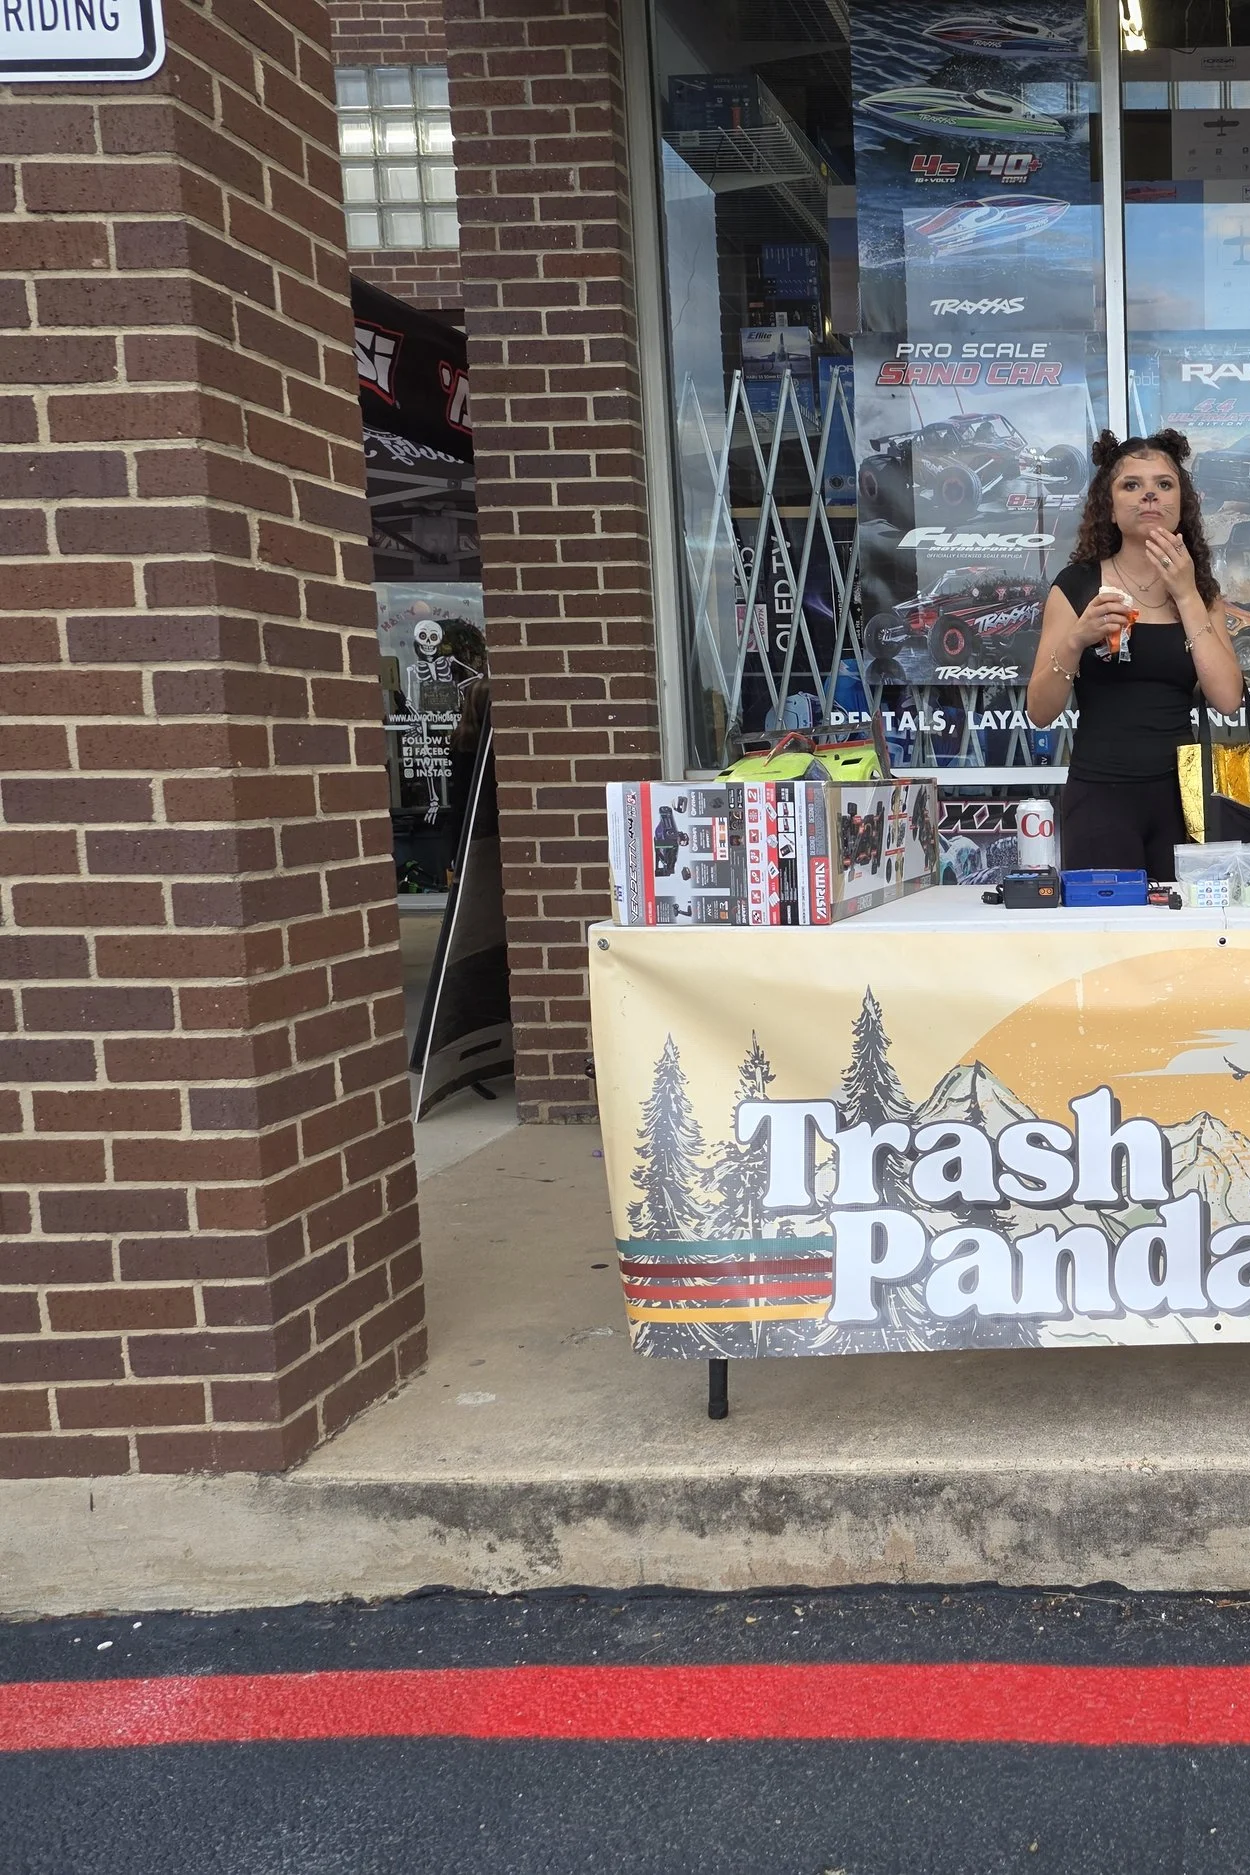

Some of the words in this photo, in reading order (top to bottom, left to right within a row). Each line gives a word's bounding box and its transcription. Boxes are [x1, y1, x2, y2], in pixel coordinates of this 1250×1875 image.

[918, 113, 957, 125] TRAXXAS
[930, 297, 1026, 316] TRAXXAS
[896, 343, 952, 358] PRO
[962, 343, 1048, 358] SCALE
[876, 361, 982, 386] SAND
[986, 361, 1063, 386] CAR
[898, 526, 1056, 548] FUNCO
[935, 665, 1019, 680] TRAXXAS
[967, 709, 1081, 731] LAYAAY
[402, 736, 443, 745] FOLLOW
[628, 838, 639, 924] VENDETTA
[734, 1085, 1172, 1210] Trash
